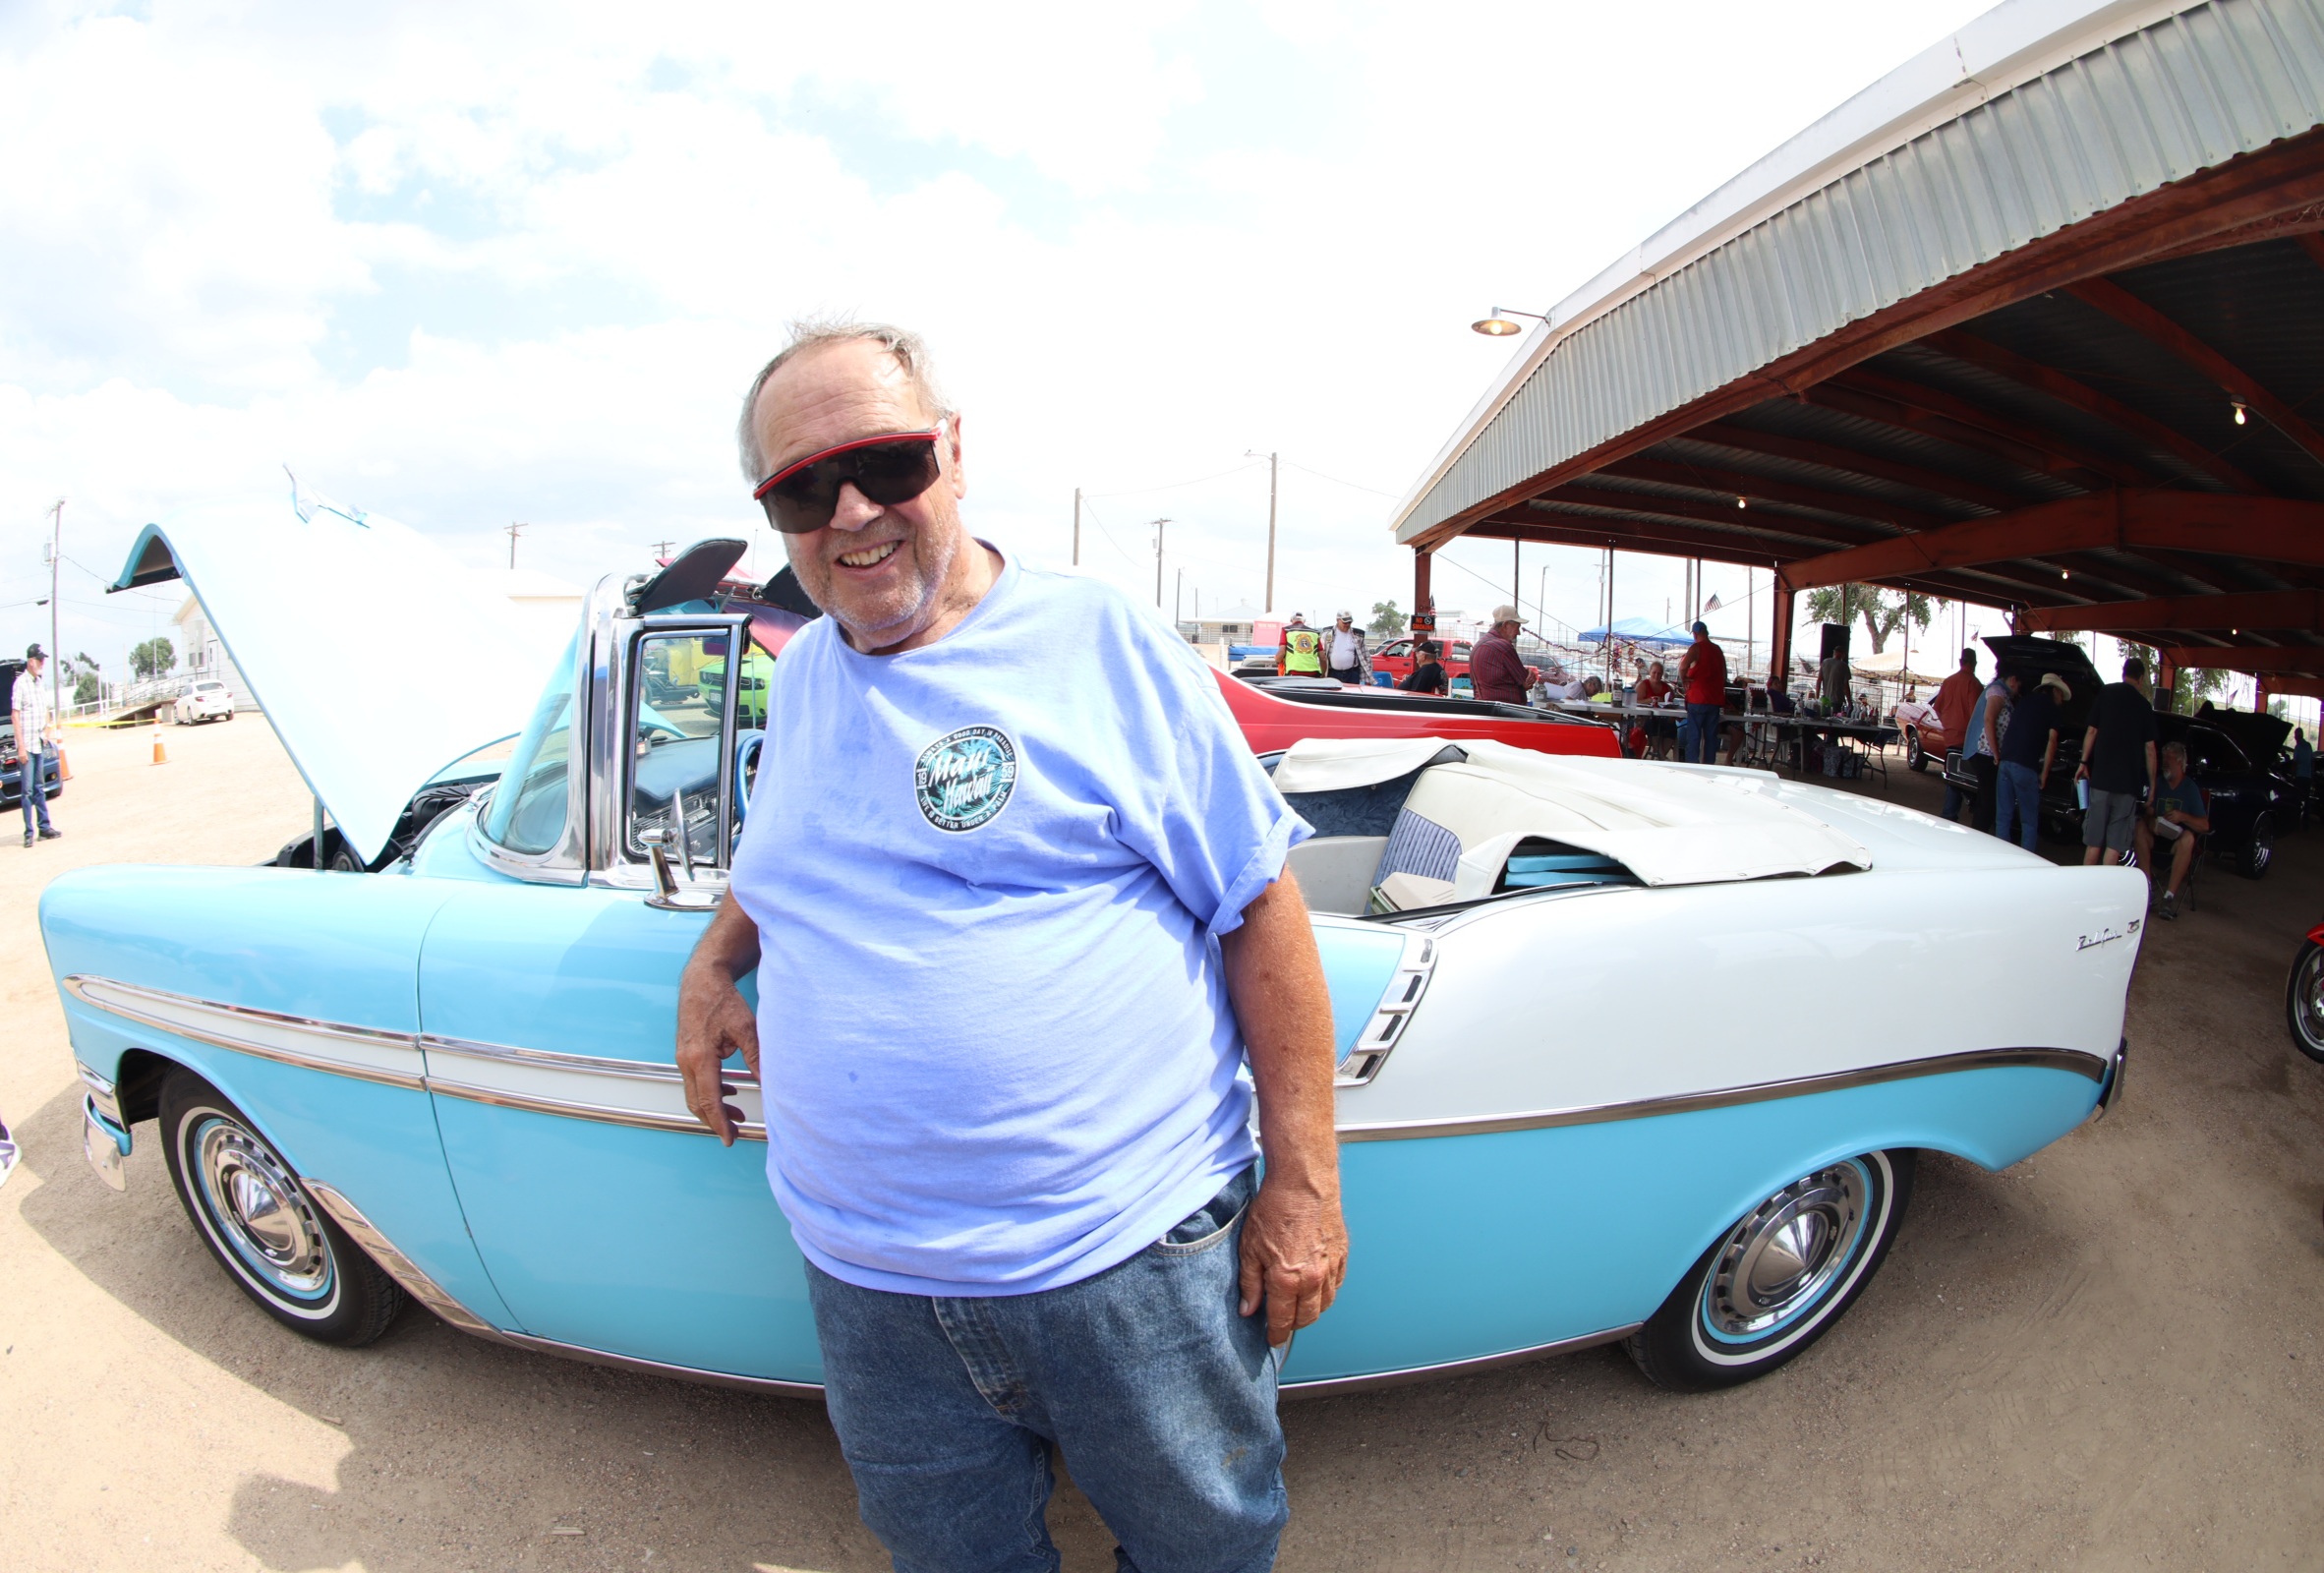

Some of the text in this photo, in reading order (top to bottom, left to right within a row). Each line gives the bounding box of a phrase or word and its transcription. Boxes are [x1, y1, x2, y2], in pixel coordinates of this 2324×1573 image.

[954, 729, 970, 739] GOOD
[993, 732, 1013, 756] PARADISE
[917, 773, 927, 785] 19
[1001, 765, 1015, 779] 59
[944, 774, 992, 812] Hawaii
[920, 796, 930, 812] LIFE
[934, 816, 959, 829] BETTER
[960, 815, 984, 828] UNDER
[993, 791, 1007, 810] PALM
